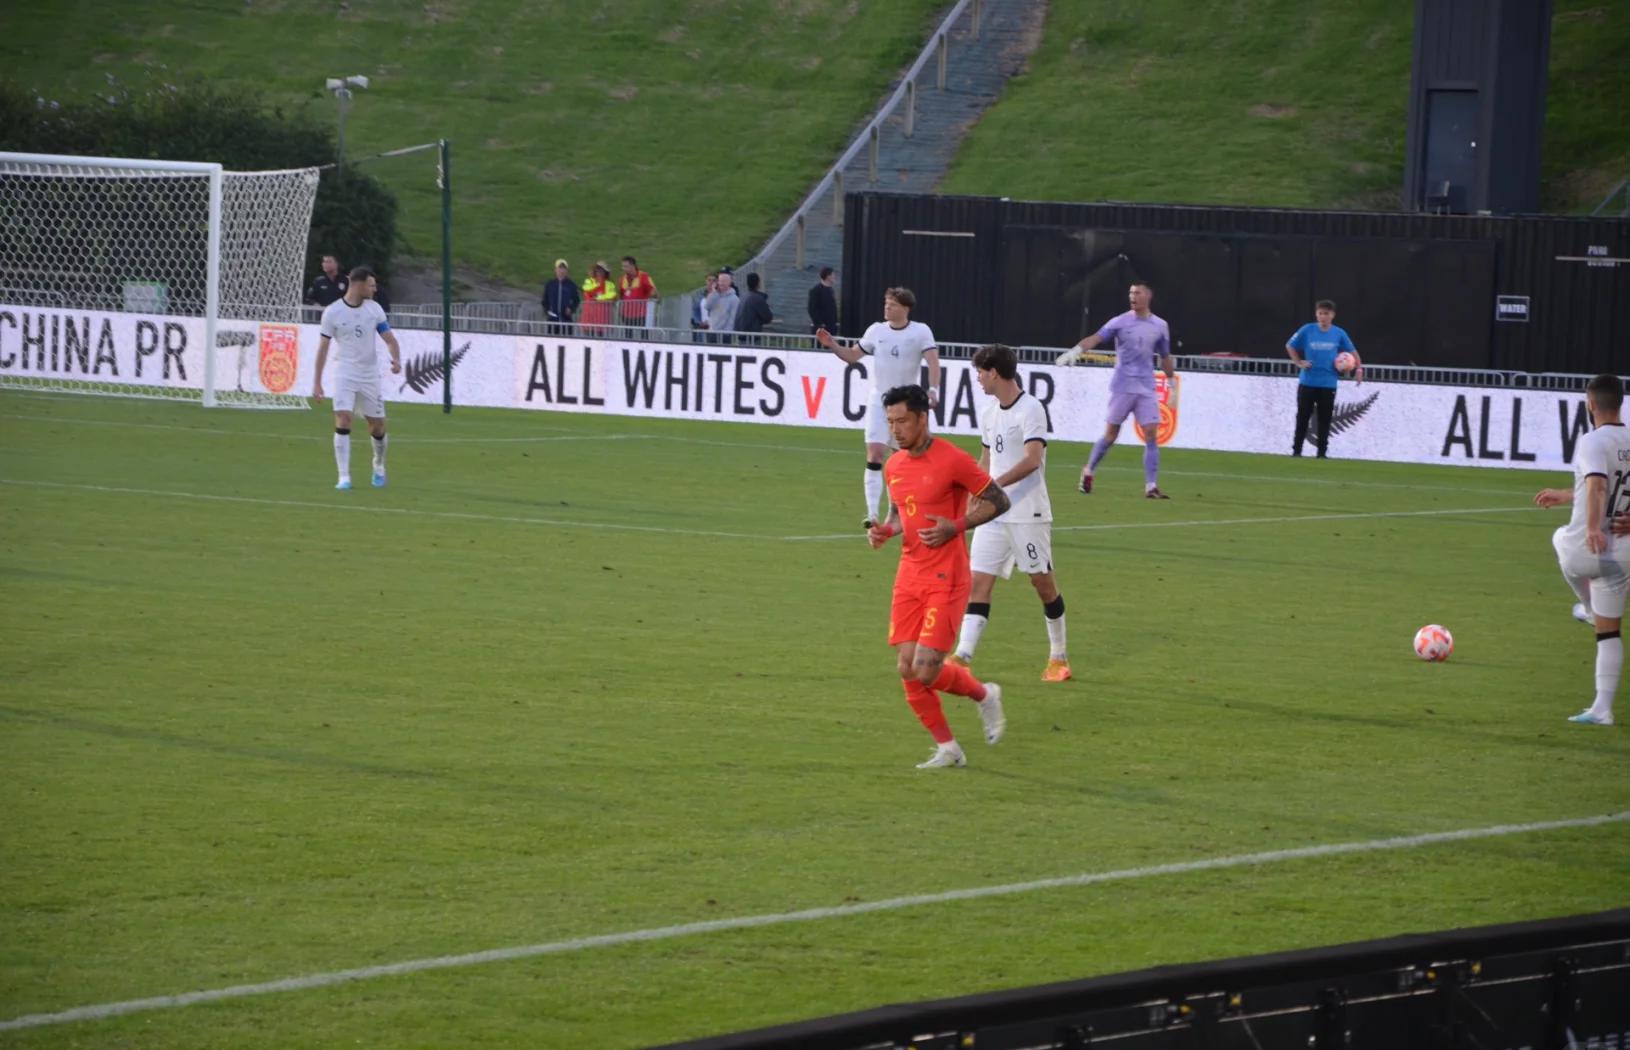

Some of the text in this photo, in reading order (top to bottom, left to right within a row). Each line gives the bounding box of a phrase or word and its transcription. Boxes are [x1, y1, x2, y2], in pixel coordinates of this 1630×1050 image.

[1499, 303, 1528, 314] WATER
[354, 326, 363, 338] 5
[0, 311, 187, 381] CHINA PR
[891, 345, 900, 359] 4
[525, 344, 605, 406] ALL
[622, 349, 786, 417] WHITES
[842, 362, 979, 429] CNA
[1441, 394, 1537, 462] ALL
[995, 434, 1005, 454] 8
[1026, 542, 1038, 560] 8
[924, 607, 938, 629] 5
